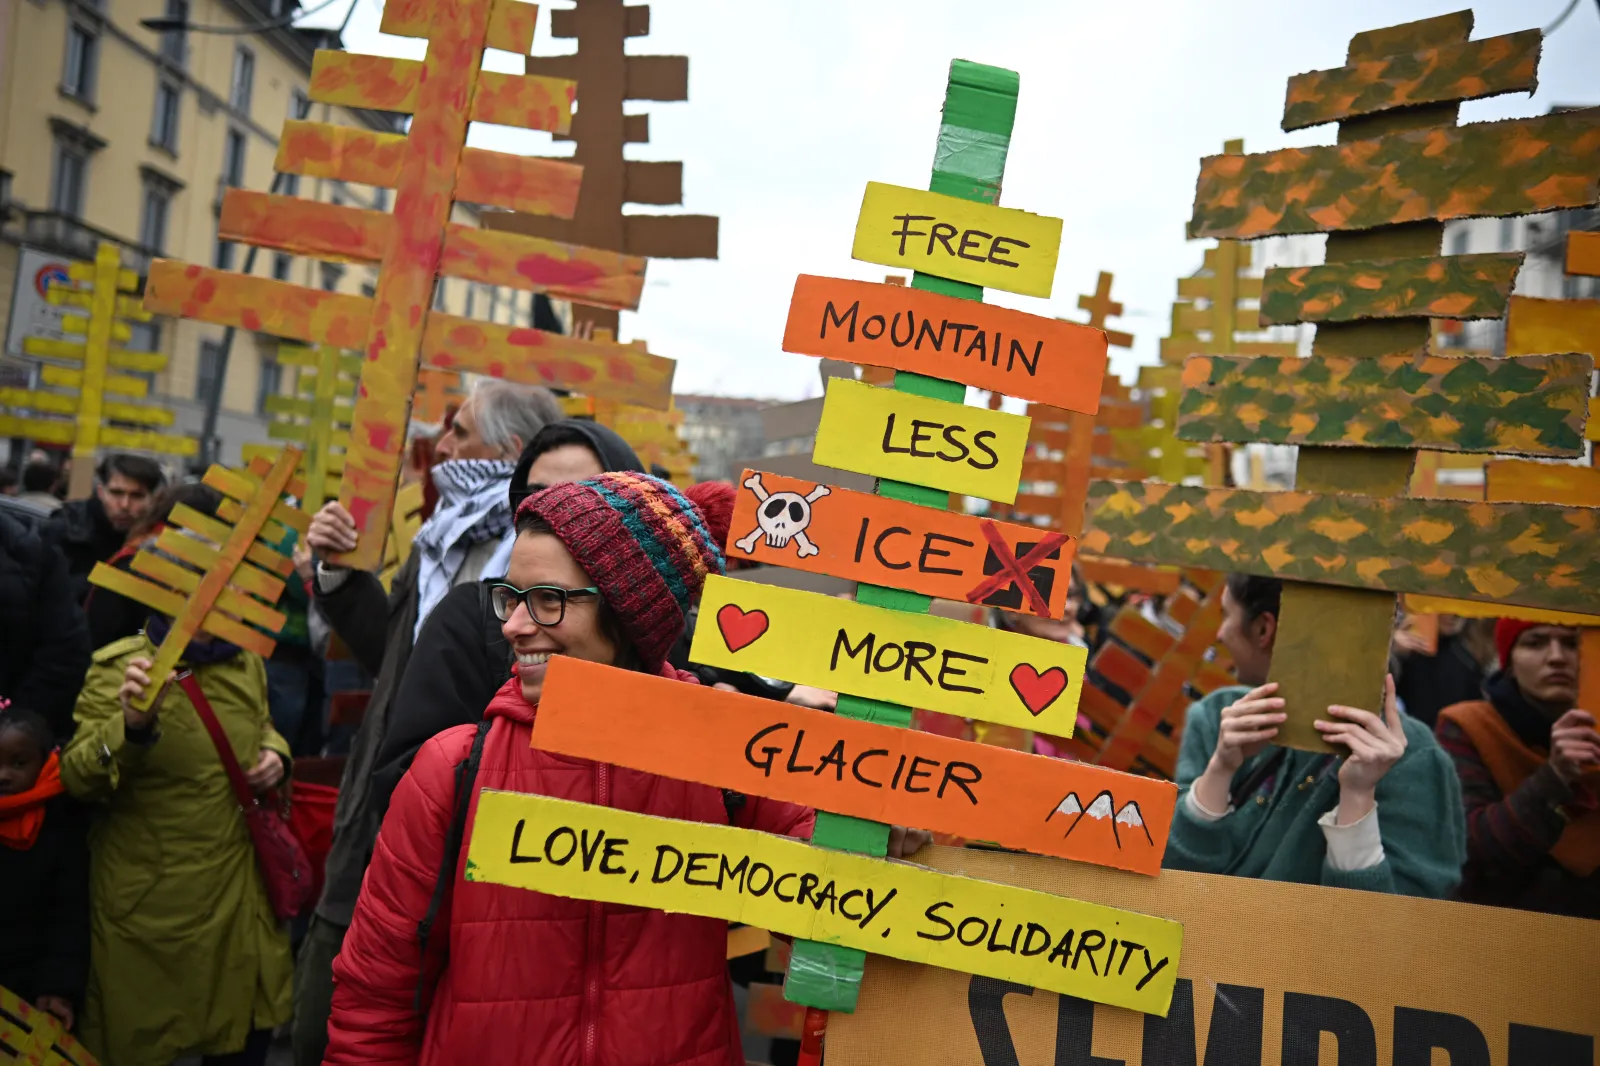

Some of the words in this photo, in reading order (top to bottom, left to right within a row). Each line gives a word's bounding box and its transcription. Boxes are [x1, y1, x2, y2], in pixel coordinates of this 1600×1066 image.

[892, 213, 1031, 268] FREE
[820, 301, 1043, 377] MOUNTAIN
[882, 412, 999, 470] LESS
[854, 517, 974, 577] ICE
[829, 622, 990, 695] MORE
[744, 722, 984, 806] GLACIER
[510, 819, 640, 884] LOVE,
[652, 844, 899, 939] DEMOCRACY,
[916, 900, 1169, 992] SOLIDARITY
